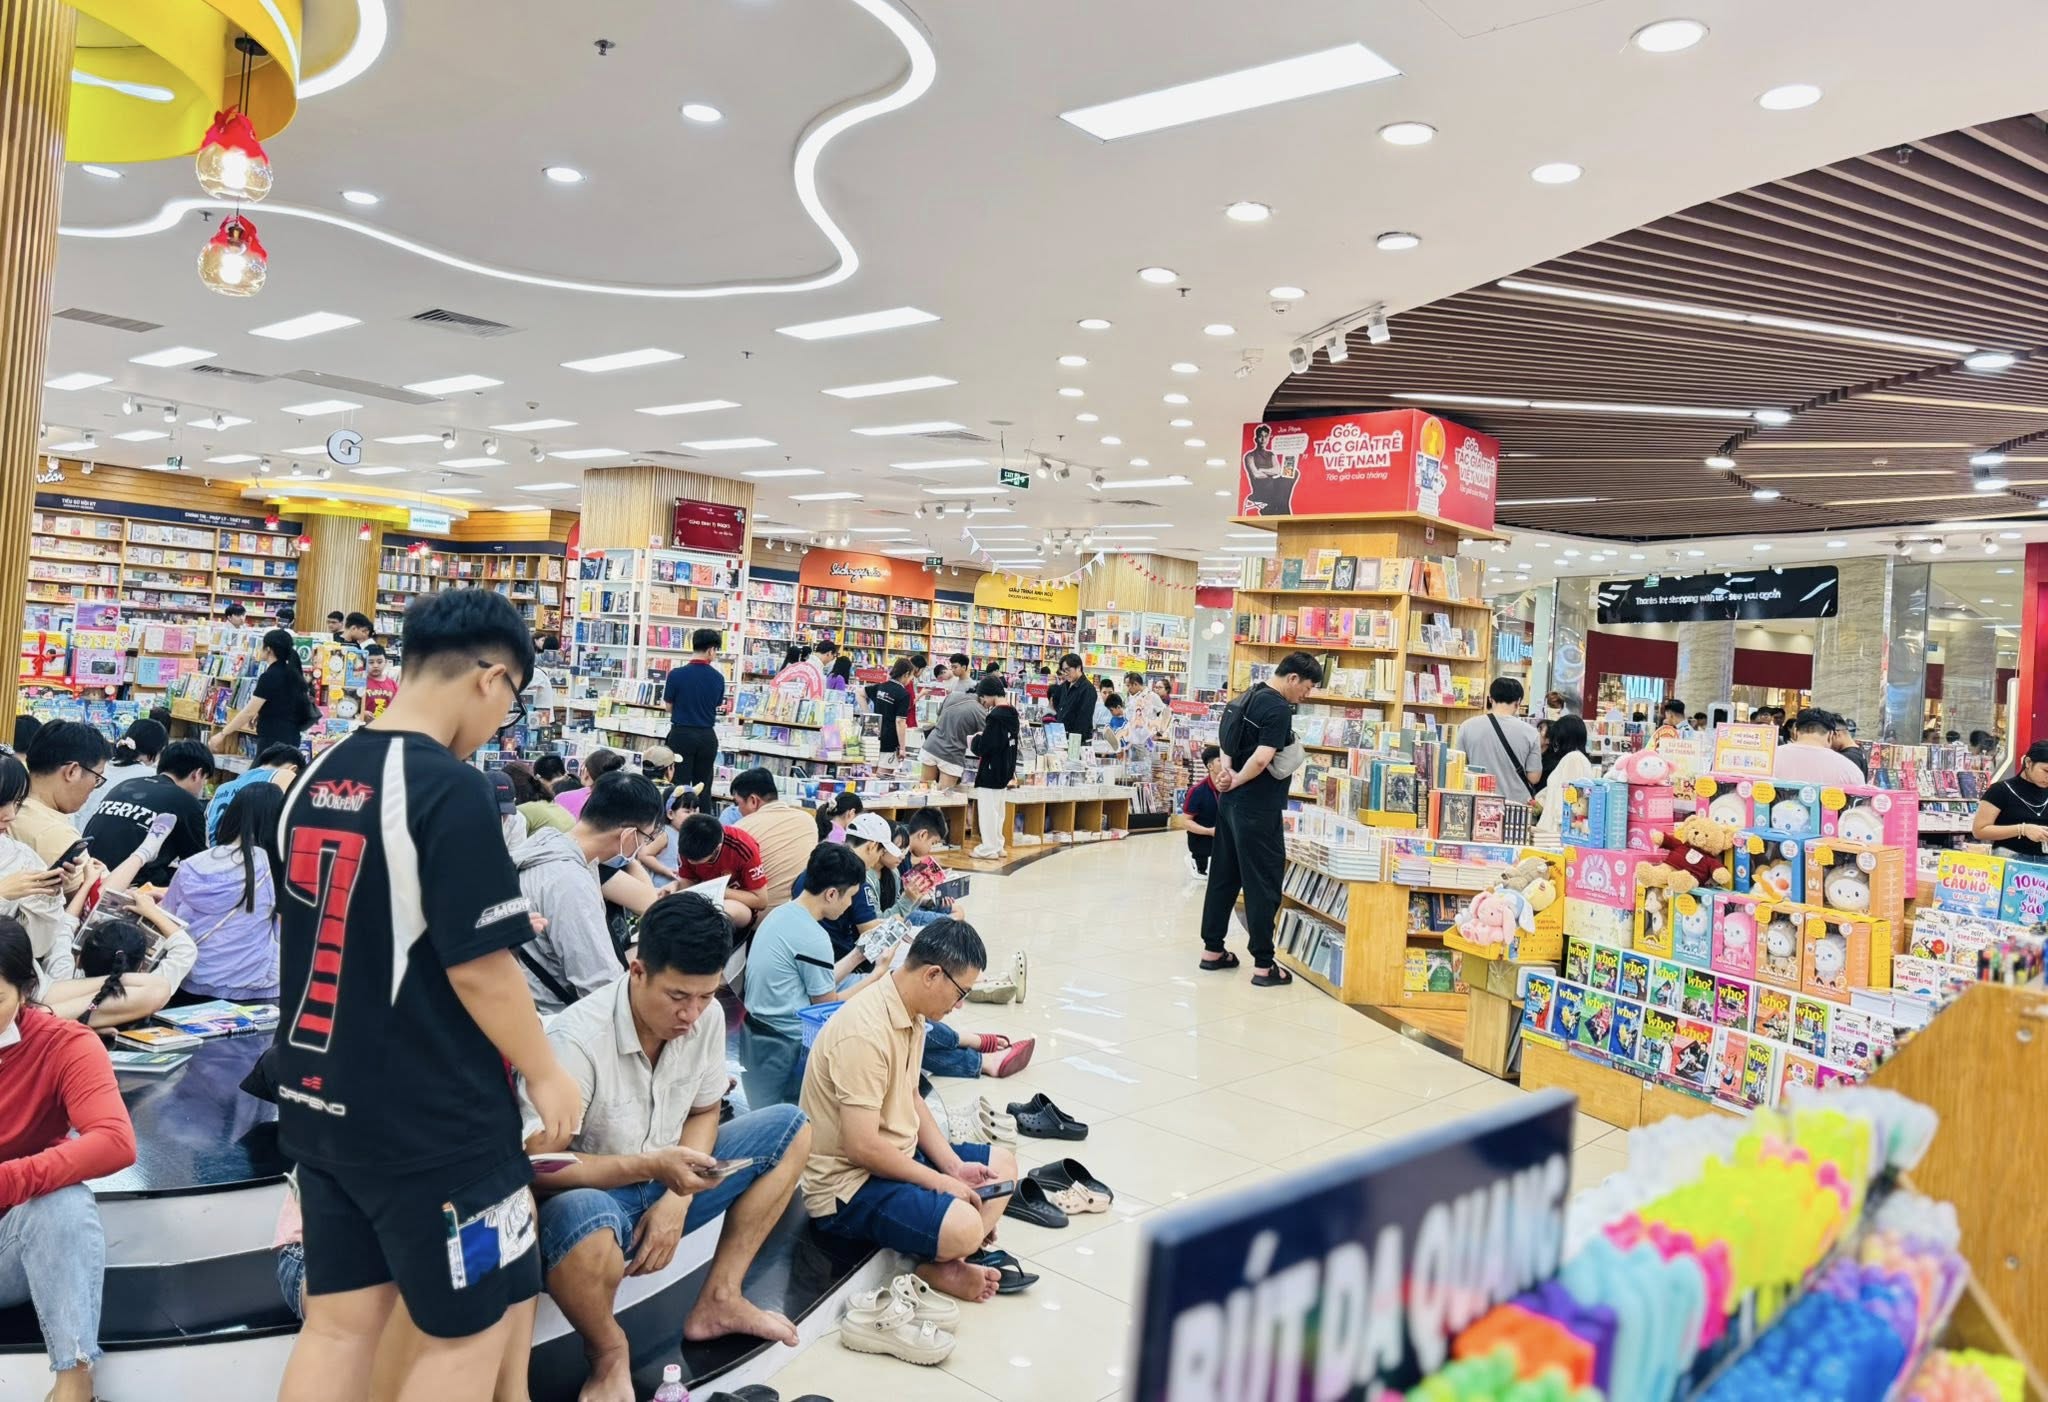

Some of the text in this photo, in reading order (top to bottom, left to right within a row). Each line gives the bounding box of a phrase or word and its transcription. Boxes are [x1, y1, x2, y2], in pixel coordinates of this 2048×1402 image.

[1333, 423, 1359, 438] Góc
[326, 429, 363, 465] G
[1315, 437, 1342, 454] TÁC
[1345, 434, 1370, 451] GIẢ
[1373, 432, 1401, 450] TRẺ
[1325, 453, 1387, 471] VIỆT NAM
[1635, 596, 1658, 605] Thanks
[1659, 595, 1668, 605] for
[1669, 595, 1699, 605] shopping
[1728, 593, 1743, 601] see
[1743, 592, 1758, 602] you
[1759, 588, 1781, 601] again
[1626, 675, 1665, 703] MUJI
[1951, 864, 1966, 875] 10
[1942, 876, 1968, 890] CÂU
[2014, 875, 2031, 889] 10
[284, 826, 368, 1053] 7
[1570, 944, 1590, 959] who?
[1596, 951, 1618, 968] who?
[1623, 960, 1648, 977] who?
[1656, 965, 1680, 981] who?
[1528, 981, 1552, 996] who?
[1687, 975, 1713, 992] who?
[1719, 985, 1747, 1002] who?
[1762, 995, 1788, 1011] who?
[1796, 1006, 1825, 1022] who?
[1647, 1016, 1676, 1033] who?
[1680, 1026, 1710, 1042] who?
[1749, 1049, 1769, 1064] who?
